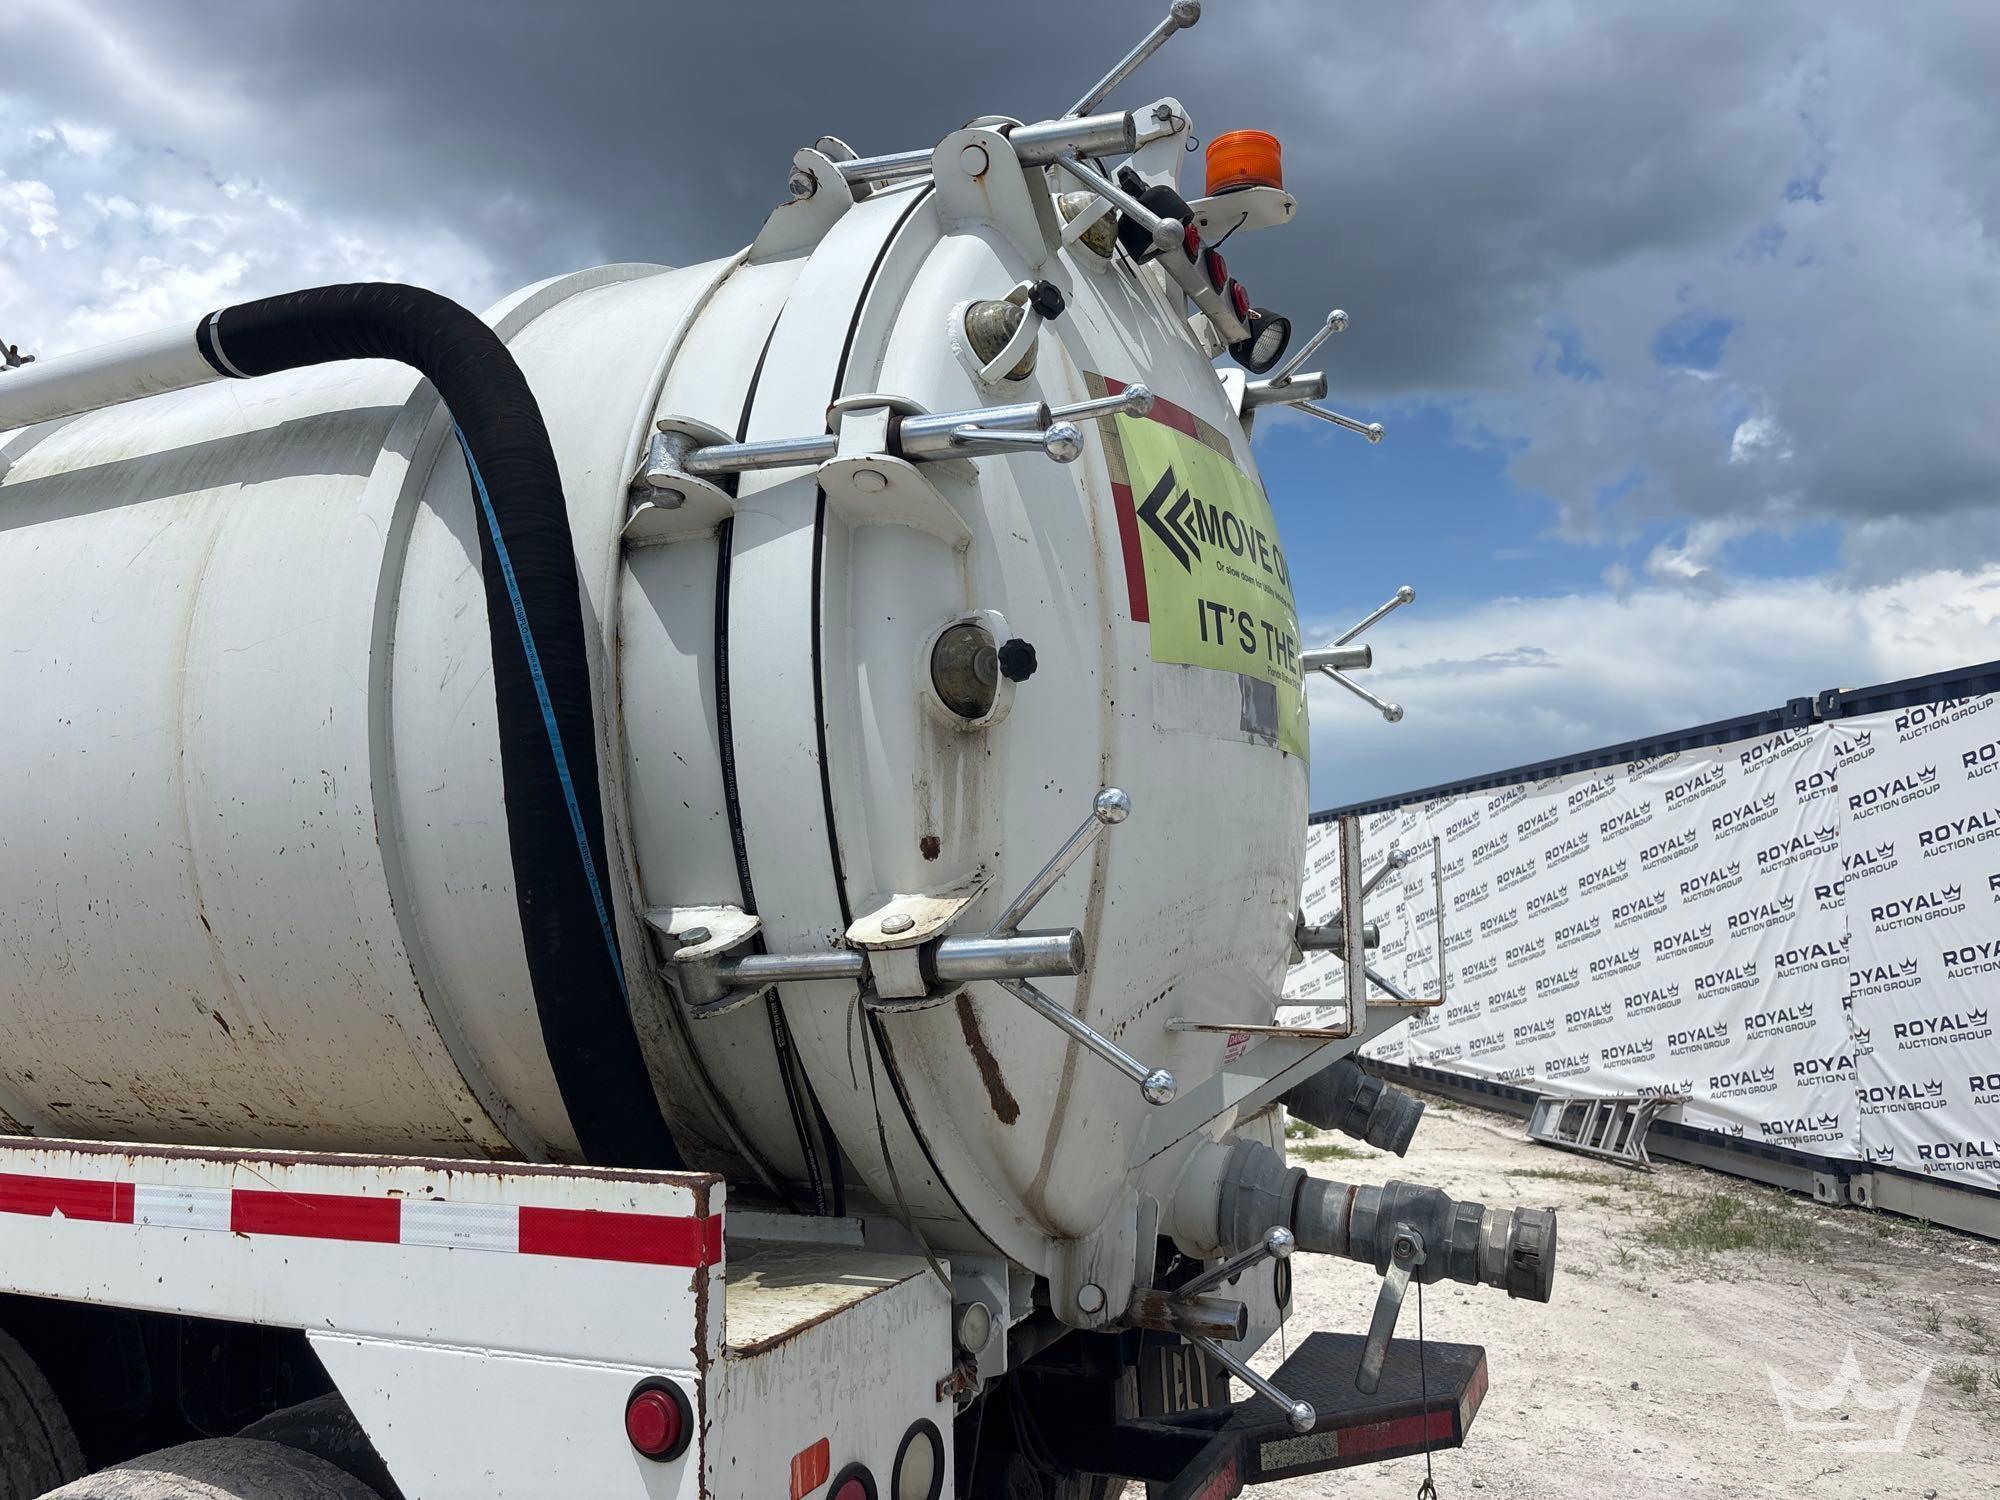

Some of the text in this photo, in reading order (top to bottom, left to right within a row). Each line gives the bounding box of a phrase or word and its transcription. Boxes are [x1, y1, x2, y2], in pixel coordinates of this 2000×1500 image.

[1193, 498, 1273, 575] MOVE
[514, 597, 528, 634] VERSIFLO
[1198, 600, 1256, 654] IT'S
[1261, 620, 1296, 674] THE
[1900, 698, 1994, 743] AUCTION GROUP
[1740, 730, 1794, 766] ROYAL
[1744, 737, 1813, 776] AUCTION GROUP
[1839, 748, 1875, 768] GROUP
[1629, 764, 1658, 783] AUCTION
[1567, 782, 1604, 807] ROYAL
[1665, 774, 1711, 803] ROYAL
[1669, 779, 1726, 811] AUCTION GROUP
[1849, 776, 1918, 810] ROYAL
[1489, 792, 1518, 812] ROYAL
[1569, 786, 1616, 814] AUCTION GROUP
[1854, 784, 1940, 820] AUCTION GROUP
[1519, 811, 1549, 834] ROYAL
[1600, 809, 1640, 834] ROYAL
[1712, 801, 1762, 831] ROYAL
[1715, 808, 1778, 840] AUCTION GROUP
[1445, 818, 1472, 837] ROYAL
[1521, 817, 1559, 841] AUCTION GROUP
[1603, 814, 1652, 842] AUCTION GROUP
[1919, 812, 1996, 847] ROYAL
[1472, 839, 1499, 859] ROYAL
[1545, 838, 1579, 861] ROYAL
[1547, 844, 1589, 868] AUCTION GROUP
[1640, 836, 1684, 862] ROYAL
[1643, 843, 1698, 871] AUCTION GROUP
[1757, 834, 1815, 865] ROYAL
[1923, 835, 1975, 859] AUCTION
[580, 840, 595, 878] VERSIFLO
[1760, 843, 1838, 875] AUCTION GROUP
[1862, 860, 1898, 876] GROUP
[1496, 865, 1526, 885] ROYAL
[1579, 866, 1616, 888] ROYAL
[1581, 873, 1628, 896] AUCTION GROUP
[1680, 869, 1728, 895] ROYAL
[1455, 887, 1481, 905] ROYAL
[1684, 876, 1742, 903] AUCTION GROUP
[1526, 891, 1558, 912] ROYAL
[1528, 898, 1568, 919] AUCTION GROUP
[1612, 897, 1654, 920] ROYAL
[1871, 893, 1942, 922] ROYAL
[1480, 913, 1508, 931] ROYAL
[1615, 905, 1667, 928] AUCTION GROUP
[1728, 903, 1779, 929] ROYAL
[1731, 912, 1795, 938] AUCTION GROUP
[1875, 904, 1965, 933] AUCTION GROUP
[1555, 921, 1590, 941] ROYAL
[1557, 929, 1601, 949] AUCTION GROUP
[1654, 930, 1699, 953] ROYAL
[1505, 942, 1535, 960] ROYAL
[1657, 939, 1714, 961] AUCTION GROUP
[1775, 942, 1840, 968] ROYAL
[1464, 960, 1489, 977] ROYAL
[1590, 953, 1628, 973] ROYAL
[1592, 961, 1641, 981] AUCTION GROUP
[1778, 962, 1818, 979] AUCTION
[1536, 972, 1569, 990] ROYAL
[1539, 981, 1579, 998] AUCTION GROUP
[1695, 968, 1743, 990] ROYAL
[1698, 978, 1759, 999] AUCTION GROUP
[1884, 977, 1921, 992] GROUP
[1490, 989, 1518, 1005] ROYAL
[1624, 989, 1667, 1009] ROYAL
[1448, 1004, 1473, 1019] ROYAL
[1566, 1006, 1601, 1024] ROYAL
[1627, 999, 1681, 1017] AUCTION GROUP
[1409, 1019, 1433, 1030] ROYAL
[1568, 1016, 1613, 1032] AUCTION GROUP
[1744, 1008, 1798, 1030] ROYAL
[1893, 1015, 1968, 1038] ROYAL
[1513, 1022, 1545, 1038] ROYAL
[1515, 1031, 1555, 1046] AUCTION GROUP
[1668, 1027, 1715, 1046] ROYAL
[1747, 1020, 1815, 1040] AUCTION GROUP
[1899, 1029, 1991, 1050] AUCTION GROUP
[1469, 1035, 1496, 1050] ROYAL
[1602, 1043, 1642, 1060] ROYAL
[1671, 1039, 1729, 1055] AUCTION GROUP
[1545, 1054, 1579, 1071] ROYAL
[1604, 1054, 1654, 1068] AUCTION GROUP
[1794, 1056, 1854, 1076] ROYA
[1709, 1071, 1761, 1089] ROYAL
[1713, 1083, 1777, 1098] AUCTION GROUP
[1797, 1074, 1845, 1087] AUCTION
[1860, 1100, 1947, 1115] AUCTION GROUP
[1760, 1116, 1818, 1135] ROYAL
[1802, 1132, 1843, 1143] GROUP
[1918, 1141, 1993, 1160] ROYAL
[1923, 1160, 1974, 1172] AUCTION
